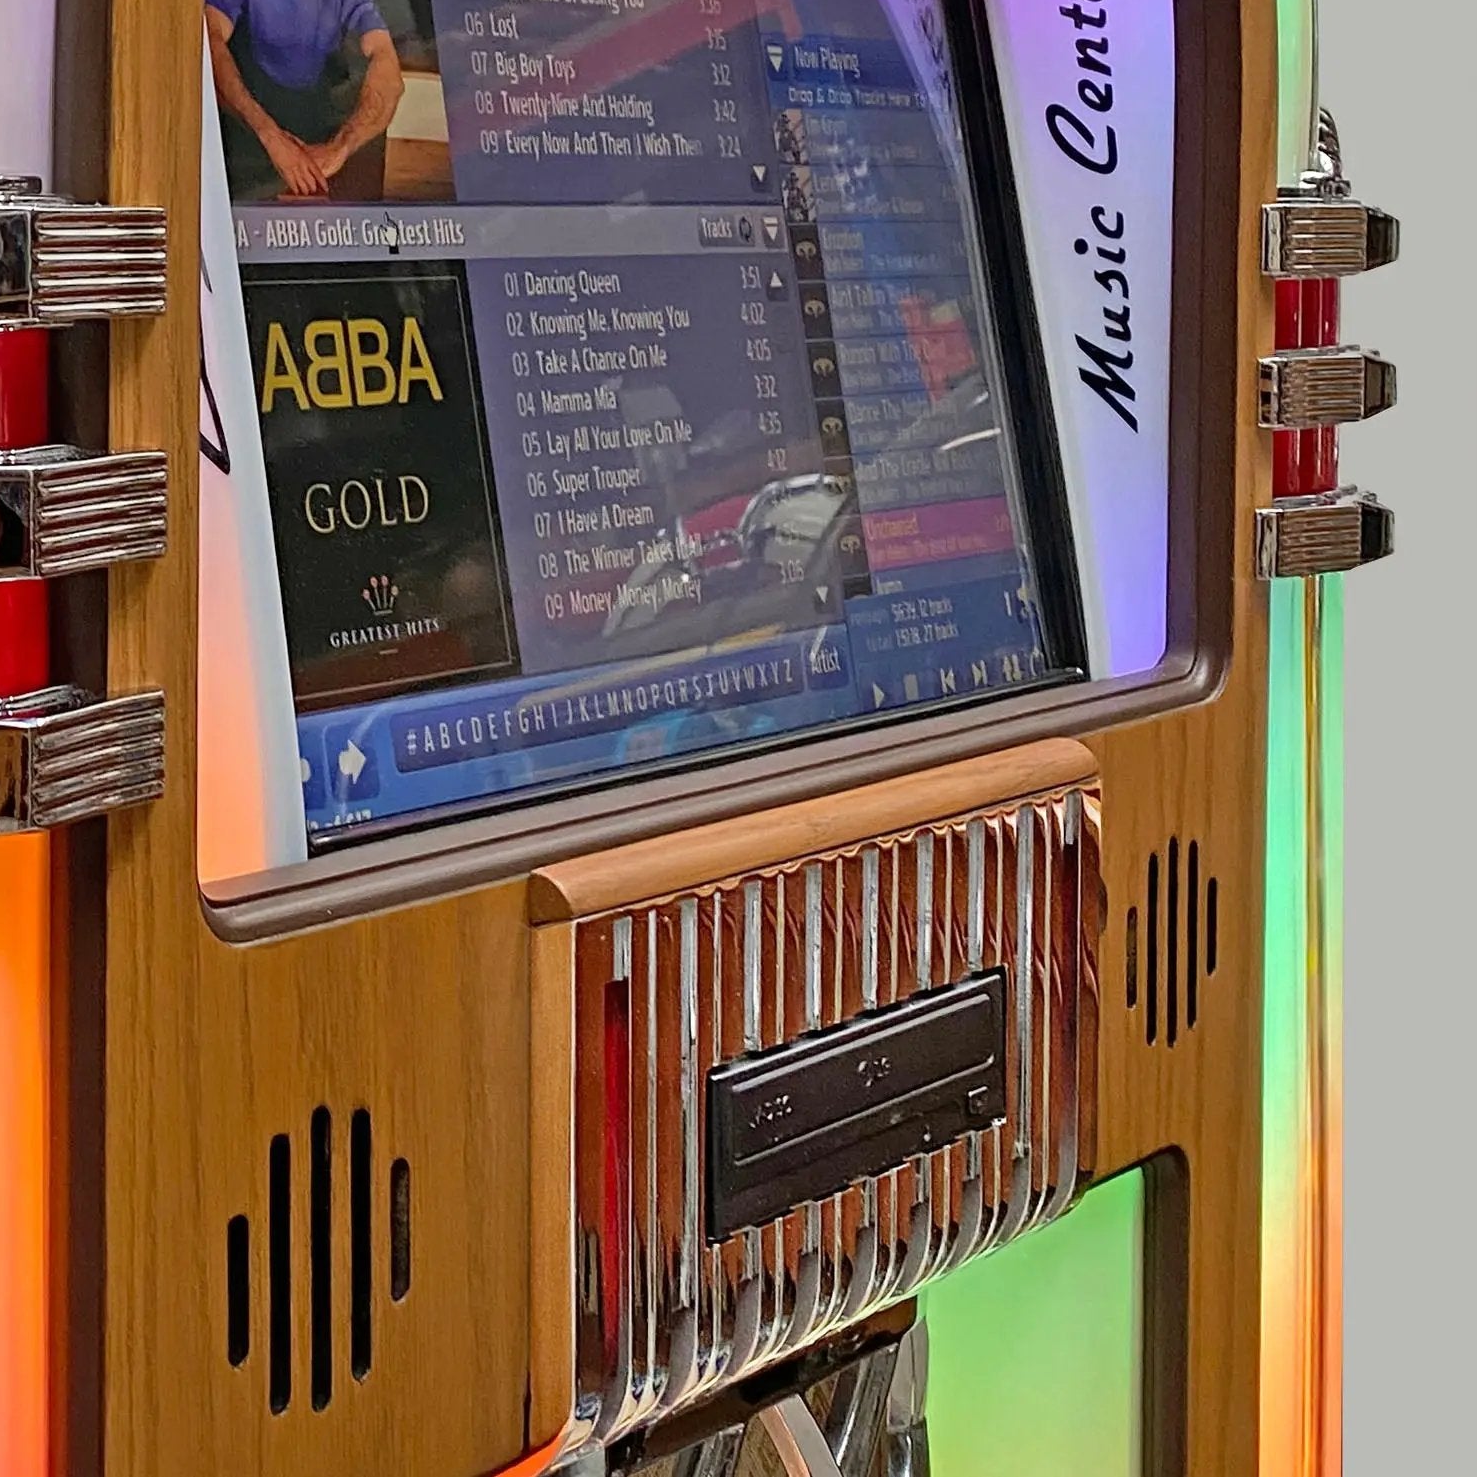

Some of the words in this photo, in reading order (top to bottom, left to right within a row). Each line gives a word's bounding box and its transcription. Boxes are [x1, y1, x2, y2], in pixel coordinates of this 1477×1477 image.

[464, 11, 484, 37] 06
[489, 11, 519, 40] Lost
[471, 51, 487, 75] 07
[495, 51, 519, 85] Big
[519, 52, 544, 85] Boy
[545, 53, 576, 84] Toys
[794, 45, 819, 70] Now
[820, 46, 861, 79] Playing
[475, 90, 494, 115] 08
[582, 93, 606, 120] And
[607, 93, 655, 127] Holding
[788, 87, 814, 107] Drag
[480, 129, 499, 154] 09
[505, 129, 540, 163] Every
[542, 130, 571, 155] Now
[573, 131, 598, 156] And
[600, 131, 632, 156] Then
[642, 132, 672, 156] Wish
[266, 219, 311, 248] ABBA
[362, 219, 433, 248] Grtest
[434, 218, 465, 245] Hits
[504, 272, 520, 297] 01
[523, 269, 577, 302] Dancing
[578, 270, 622, 296] Queen
[506, 312, 524, 337] 02
[530, 309, 587, 341] Knowing
[611, 305, 666, 337] Knowing
[666, 305, 690, 328] You
[1073, 204, 1138, 435] Music
[261, 316, 444, 413] ABBA
[512, 352, 530, 377] 03
[535, 348, 568, 375] Take
[571, 348, 581, 374] A
[582, 347, 626, 372] Chance
[629, 345, 647, 369] On
[648, 344, 667, 368] Me
[516, 392, 535, 417] 04
[540, 387, 593, 414] Mamma
[594, 386, 617, 410] Mia
[523, 431, 541, 457] 05
[547, 430, 571, 462] Lay
[575, 426, 591, 452] All
[591, 425, 621, 451] Your
[623, 423, 652, 448] Love
[654, 420, 673, 444] On
[674, 419, 692, 442] Me
[527, 472, 547, 498] 06
[552, 468, 590, 502] Super
[592, 465, 641, 496] Trouper
[304, 475, 429, 535] GOLD
[534, 512, 551, 538] 07
[557, 511, 565, 536] I
[566, 508, 598, 534] Have
[602, 505, 612, 530] A
[613, 503, 654, 529] Dream
[538, 553, 559, 579] 08
[564, 549, 591, 575] The
[592, 544, 635, 571] Winner
[637, 539, 674, 568] Takes
[544, 593, 565, 620] 09
[662, 577, 702, 604] Money
[329, 623, 400, 648] GREATEST
[405, 617, 440, 637] HITS
